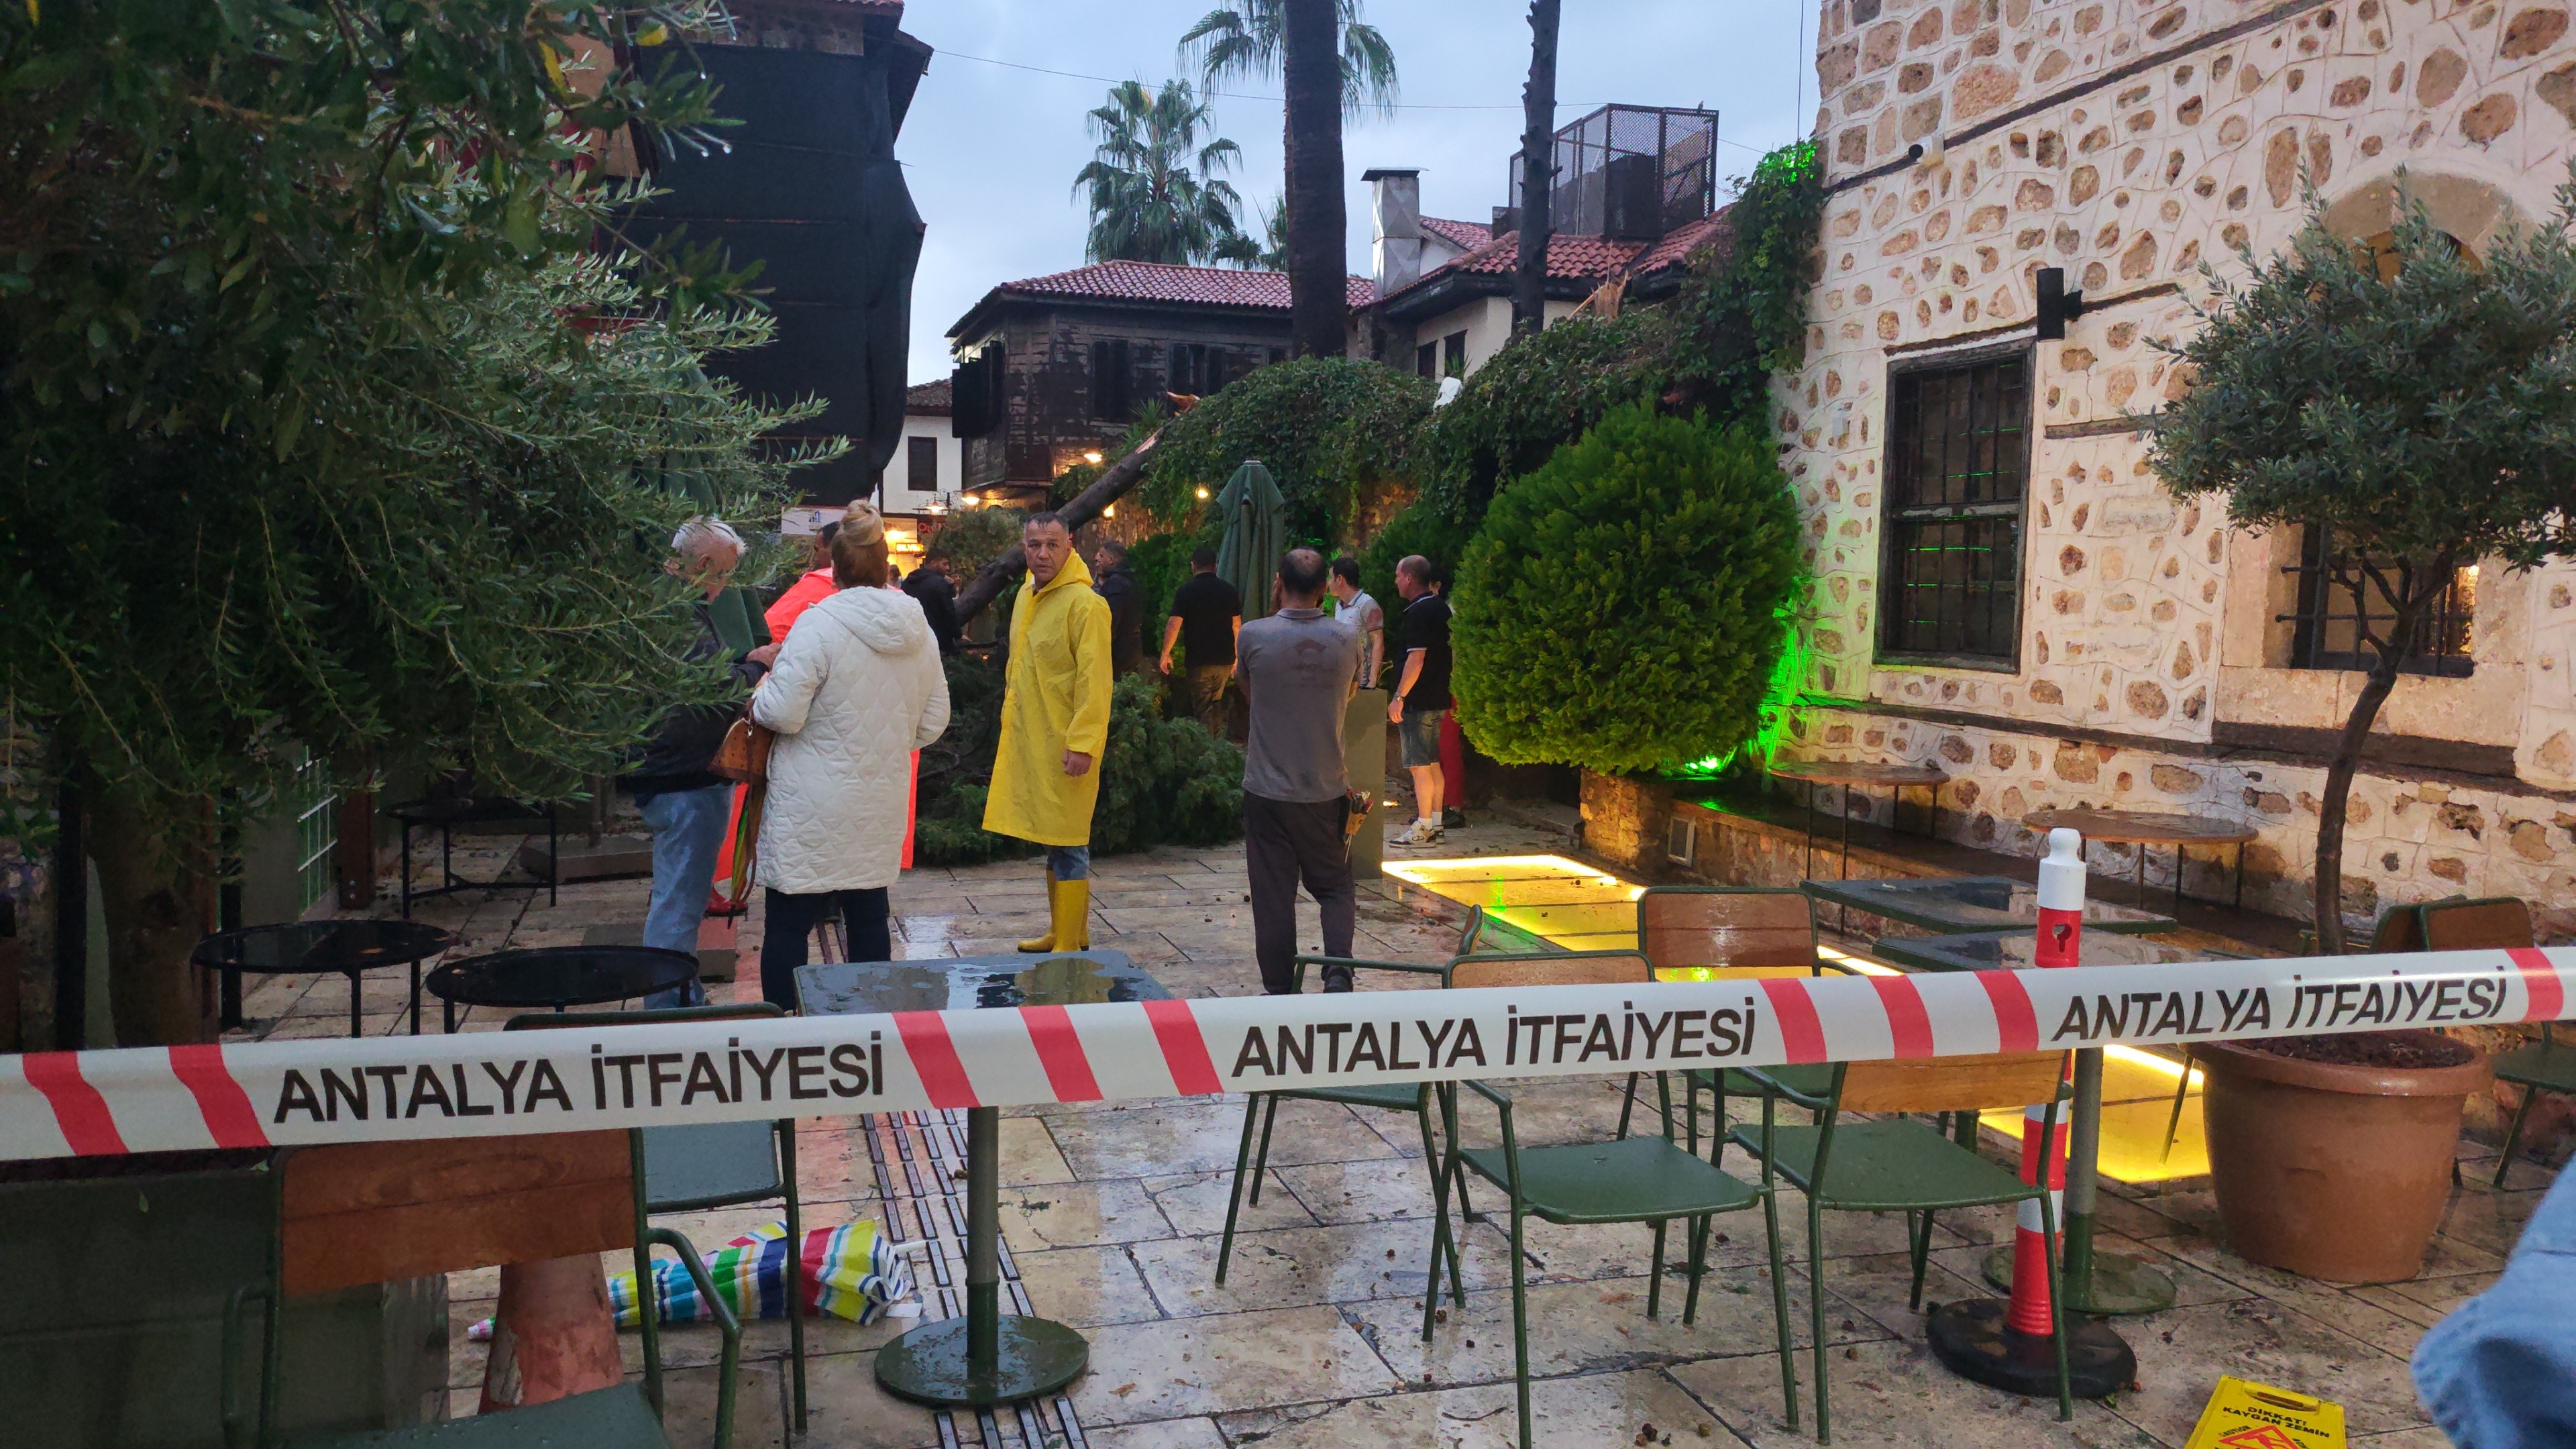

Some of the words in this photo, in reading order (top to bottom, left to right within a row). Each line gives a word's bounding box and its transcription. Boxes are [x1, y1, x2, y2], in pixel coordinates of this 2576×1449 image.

[1231, 1018, 1487, 1077] ANTALYA
[1505, 996, 1755, 1065] İTFAİYESİ
[2051, 987, 2271, 1041] ANTALYA
[2286, 965, 2507, 1028] İTFAİYESİ
[273, 1059, 574, 1124] ANTALYA
[591, 1030, 883, 1110] İTFAİYESİ
[2222, 1406, 2281, 1425] KAYGAN
[2285, 1421, 2330, 1438] ZEMİN
